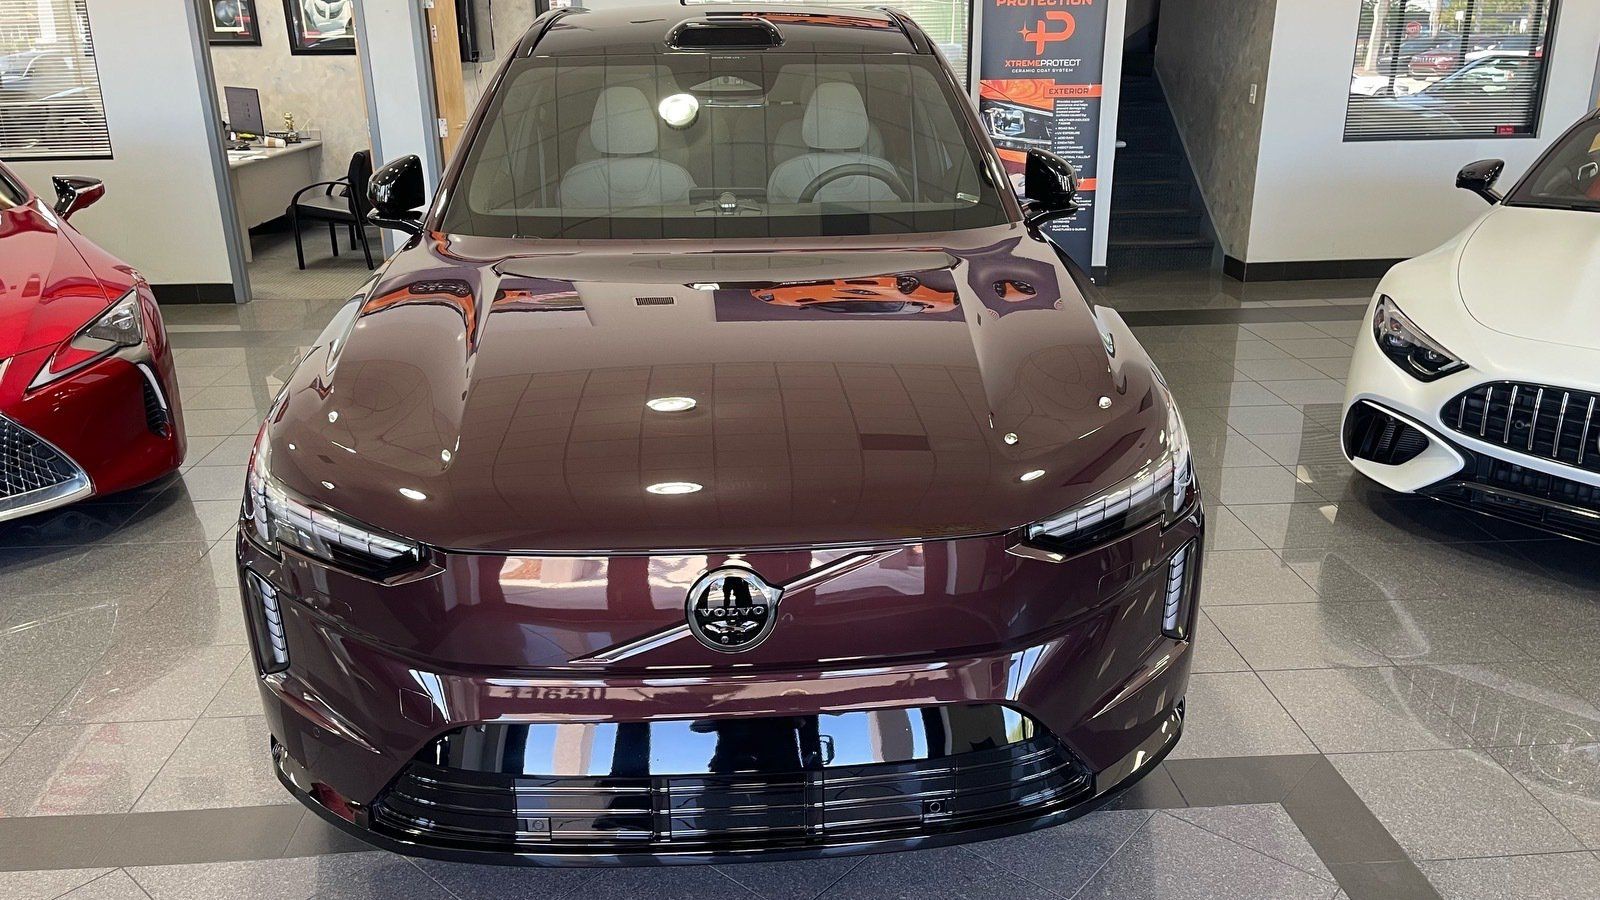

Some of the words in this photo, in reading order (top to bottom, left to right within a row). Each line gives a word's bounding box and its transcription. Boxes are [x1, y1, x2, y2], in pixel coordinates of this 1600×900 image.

[1004, 59, 1082, 68] XTREMEPROTECT
[1048, 87, 1089, 95] EXTERIOR
[698, 606, 765, 617] VOLVO
